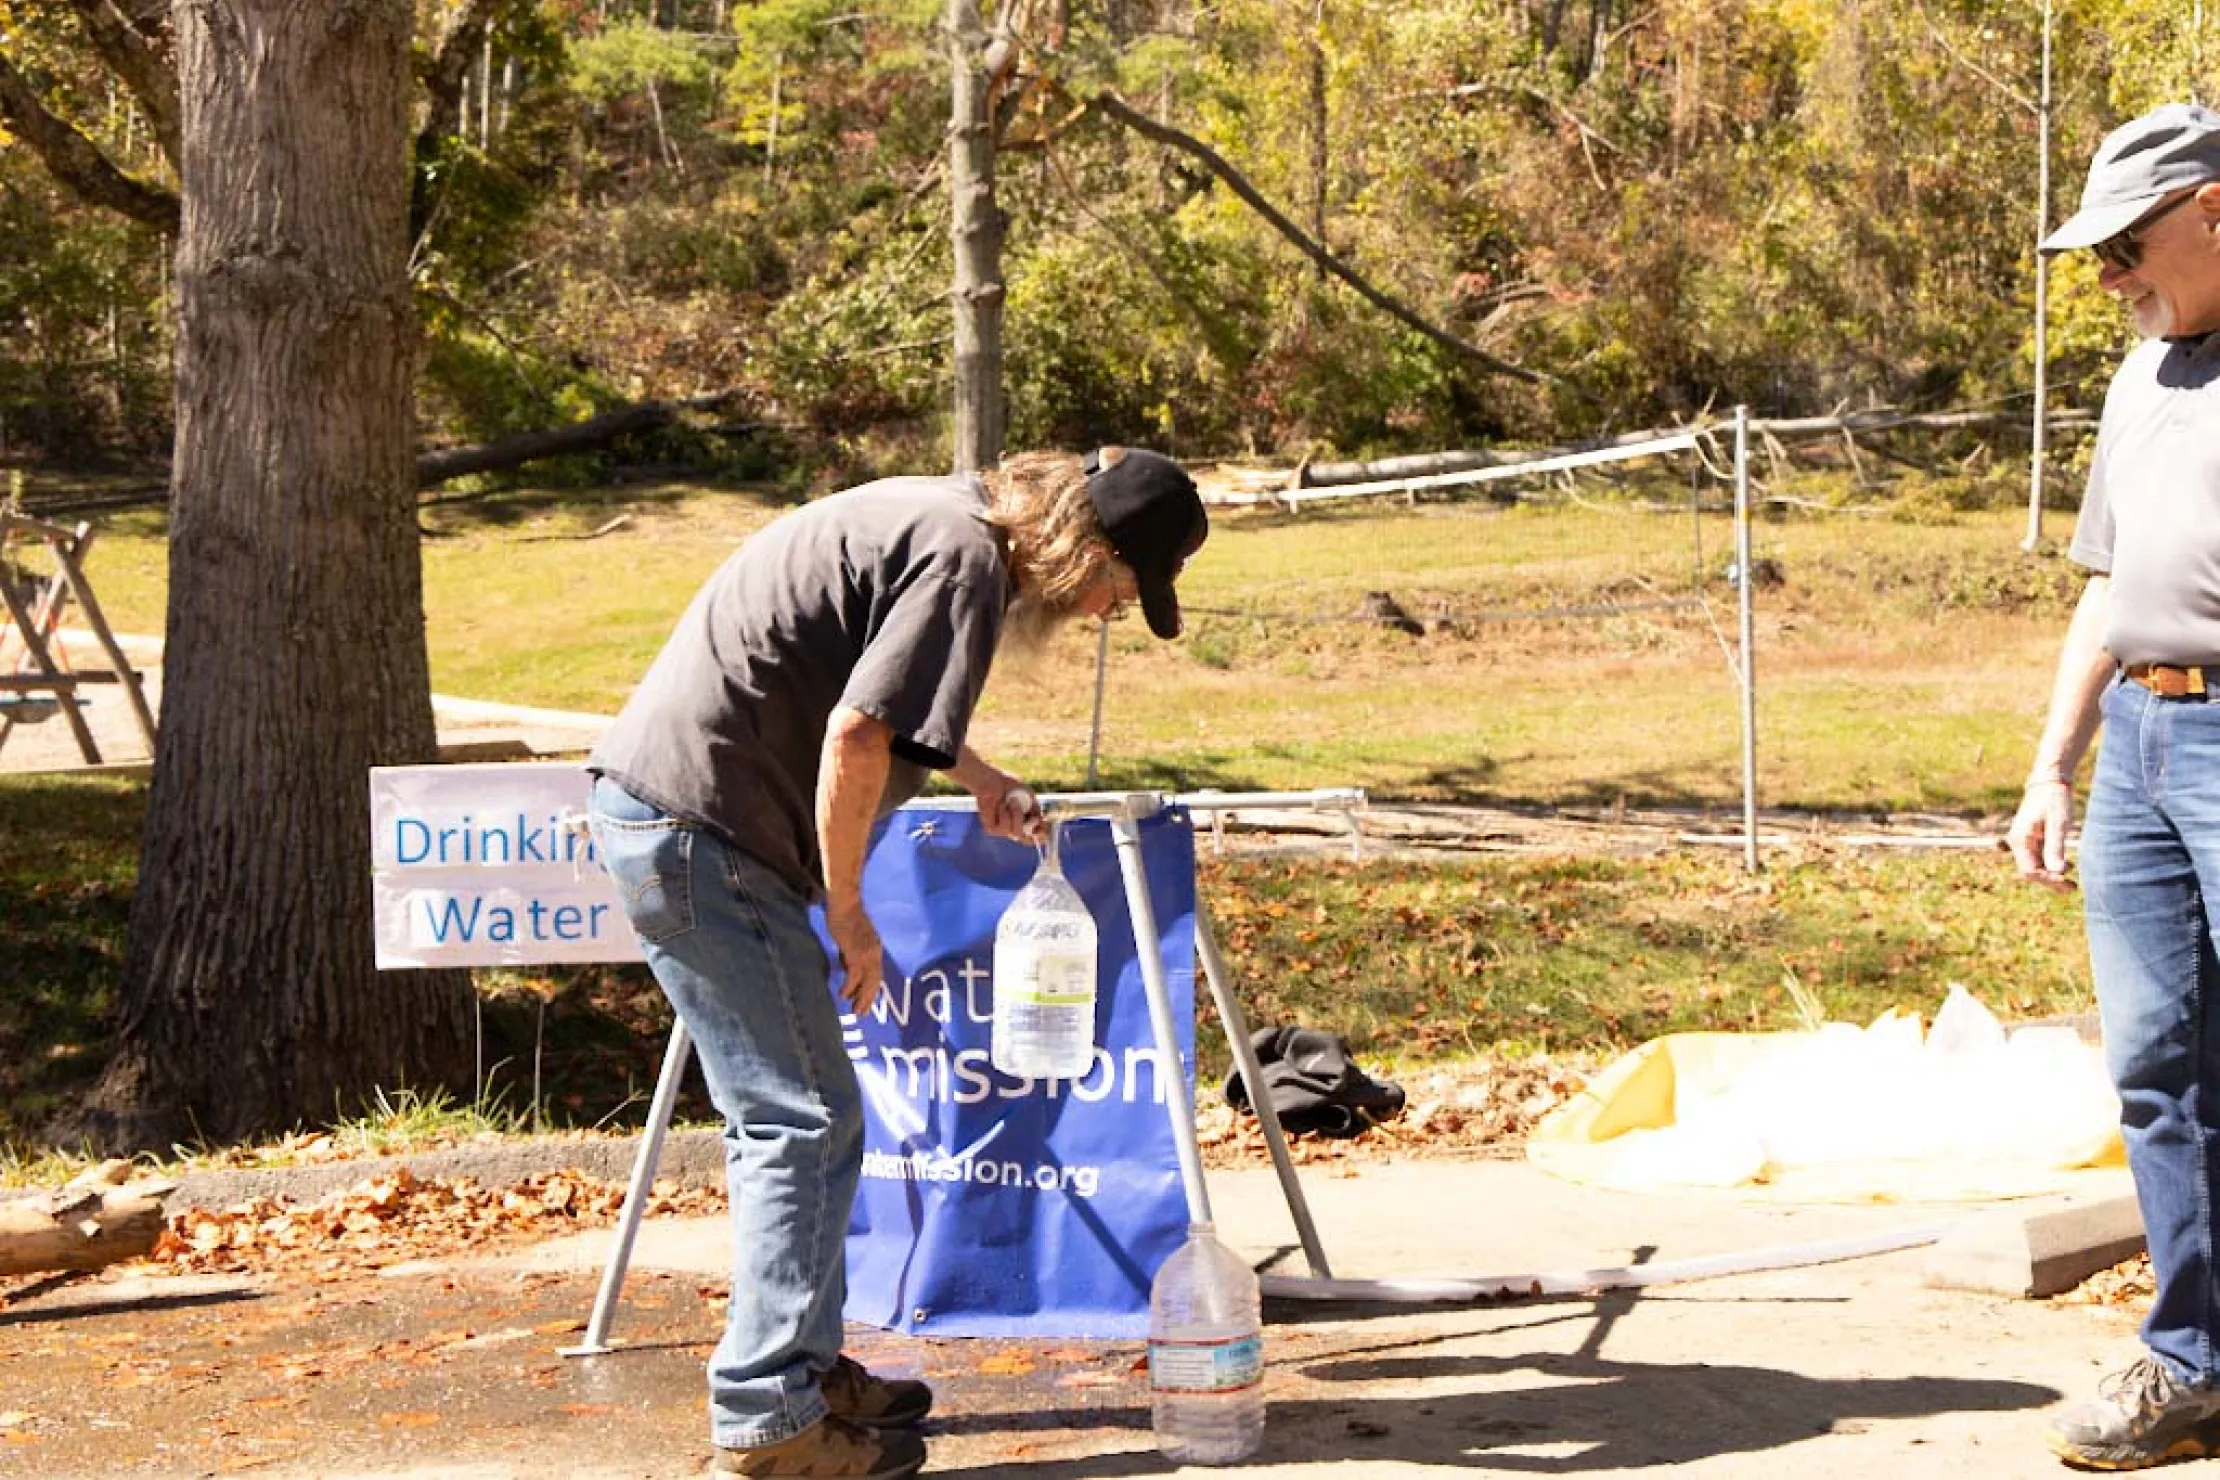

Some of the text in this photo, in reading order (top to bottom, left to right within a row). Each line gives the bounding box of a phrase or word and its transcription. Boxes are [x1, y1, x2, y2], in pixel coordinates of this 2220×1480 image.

[397, 813, 596, 863] Drinkin
[425, 896, 608, 943] Water
[870, 957, 995, 1026] wat
